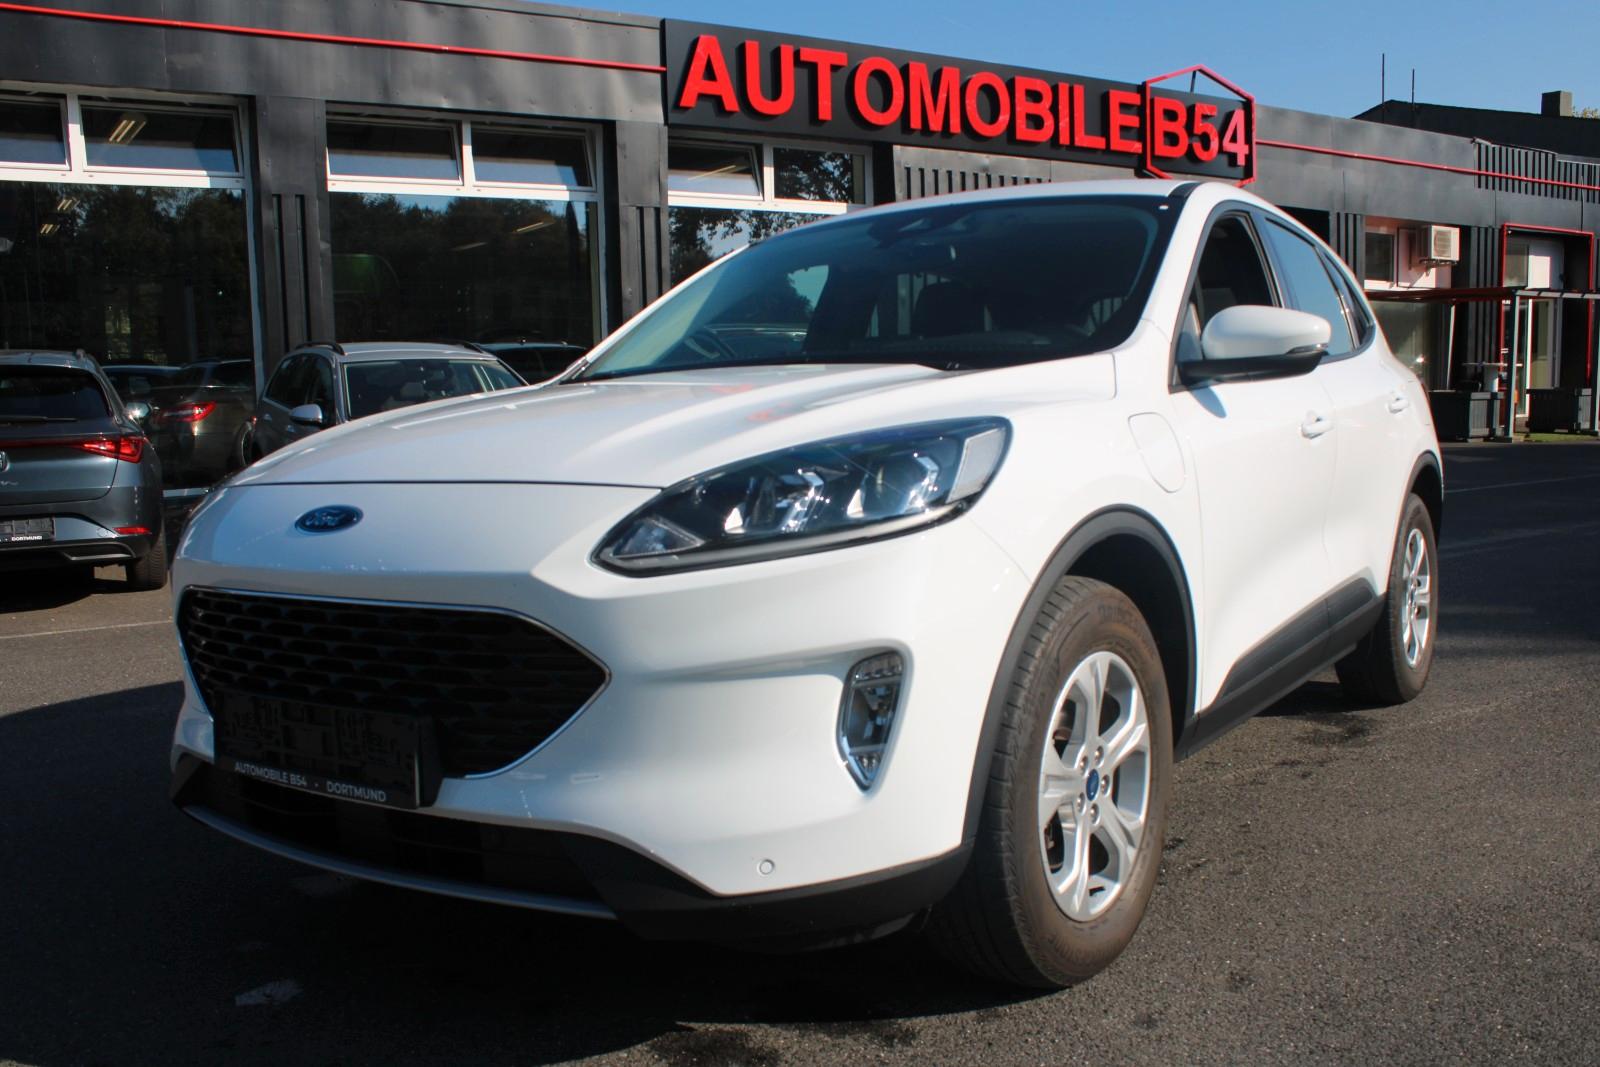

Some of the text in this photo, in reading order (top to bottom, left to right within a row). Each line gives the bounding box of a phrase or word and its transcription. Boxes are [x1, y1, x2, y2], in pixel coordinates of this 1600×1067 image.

[680, 34, 1249, 167] AUTOMOBILE B54
[235, 762, 386, 802] AUTOMOBILE B54 DORTMUND
